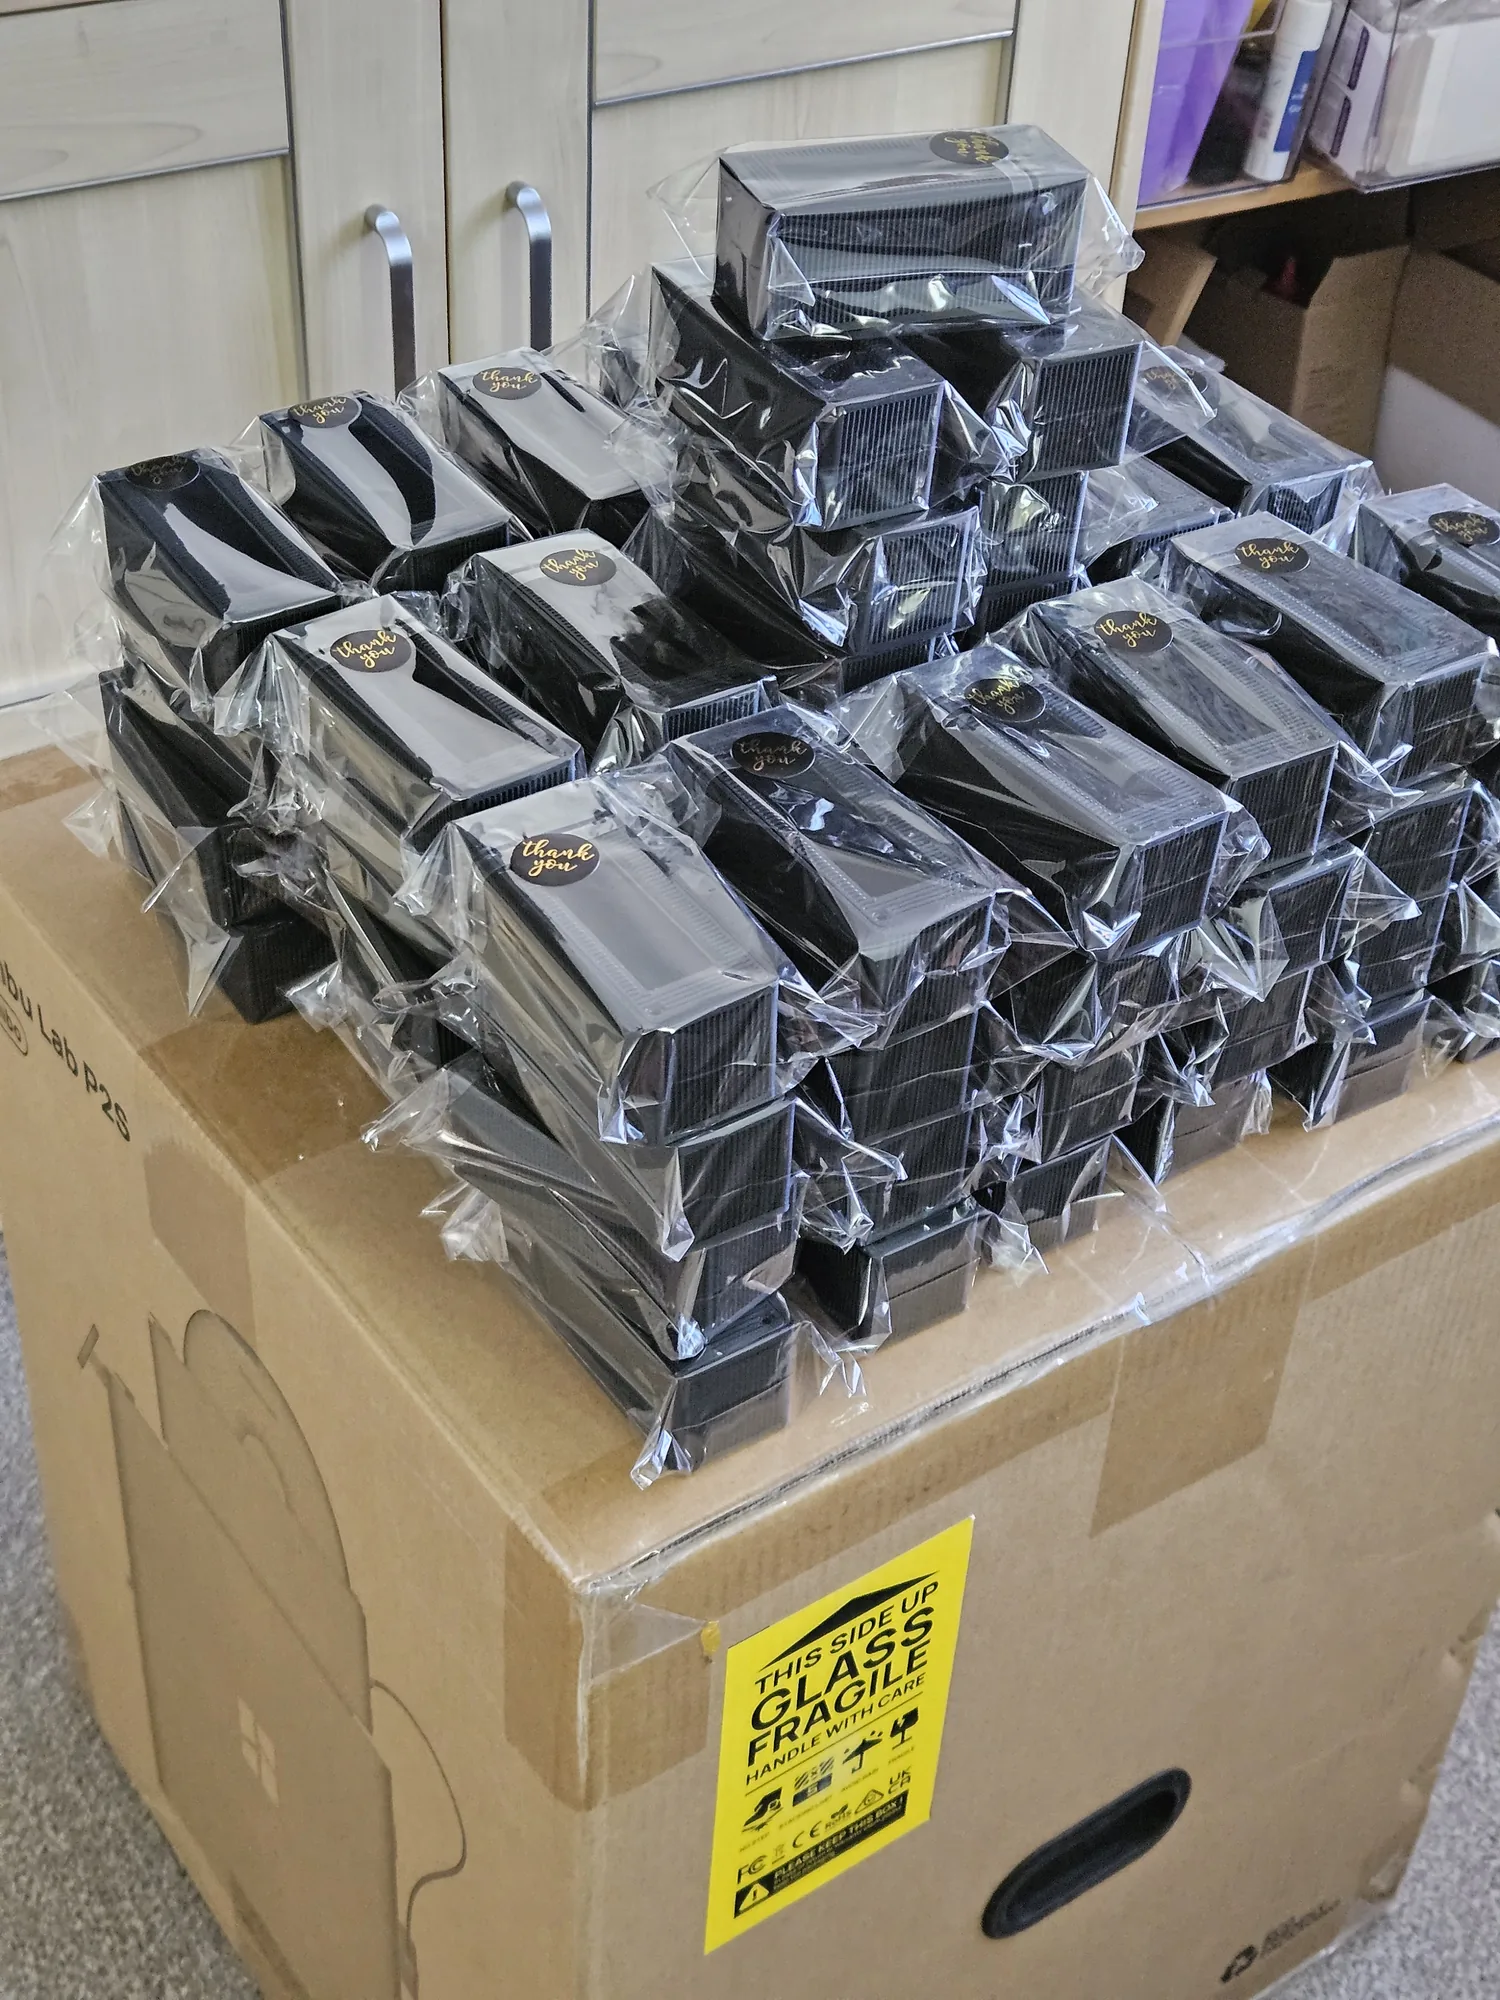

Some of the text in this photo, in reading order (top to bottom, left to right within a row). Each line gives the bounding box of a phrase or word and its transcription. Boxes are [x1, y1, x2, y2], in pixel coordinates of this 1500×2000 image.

[480, 369, 539, 384] thank
[489, 381, 527, 393] you
[293, 396, 346, 417] thank
[312, 406, 344, 424] you
[1434, 513, 1487, 533] thank
[1237, 541, 1300, 558] thank
[541, 548, 596, 574] thank
[569, 560, 599, 581] you
[1259, 555, 1295, 570] you
[1096, 611, 1158, 636] thank
[333, 630, 397, 658] thank
[1122, 629, 1157, 648] you
[360, 646, 396, 669] you
[737, 740, 808, 755] thank
[753, 754, 796, 771] you
[522, 839, 595, 861] thank
[528, 858, 578, 877] you
[37, 1003, 79, 1077] Lab
[83, 1060, 131, 1142] P2S
[754, 1581, 939, 1695] THIS SIDE UP
[751, 1606, 935, 1731] GLASS
[747, 1638, 931, 1767] FRAGILE
[746, 1732, 822, 1786] HANDLE
[825, 1703, 874, 1739] WITH
[877, 1672, 926, 1709] CARE
[792, 1820, 822, 1849] CE
